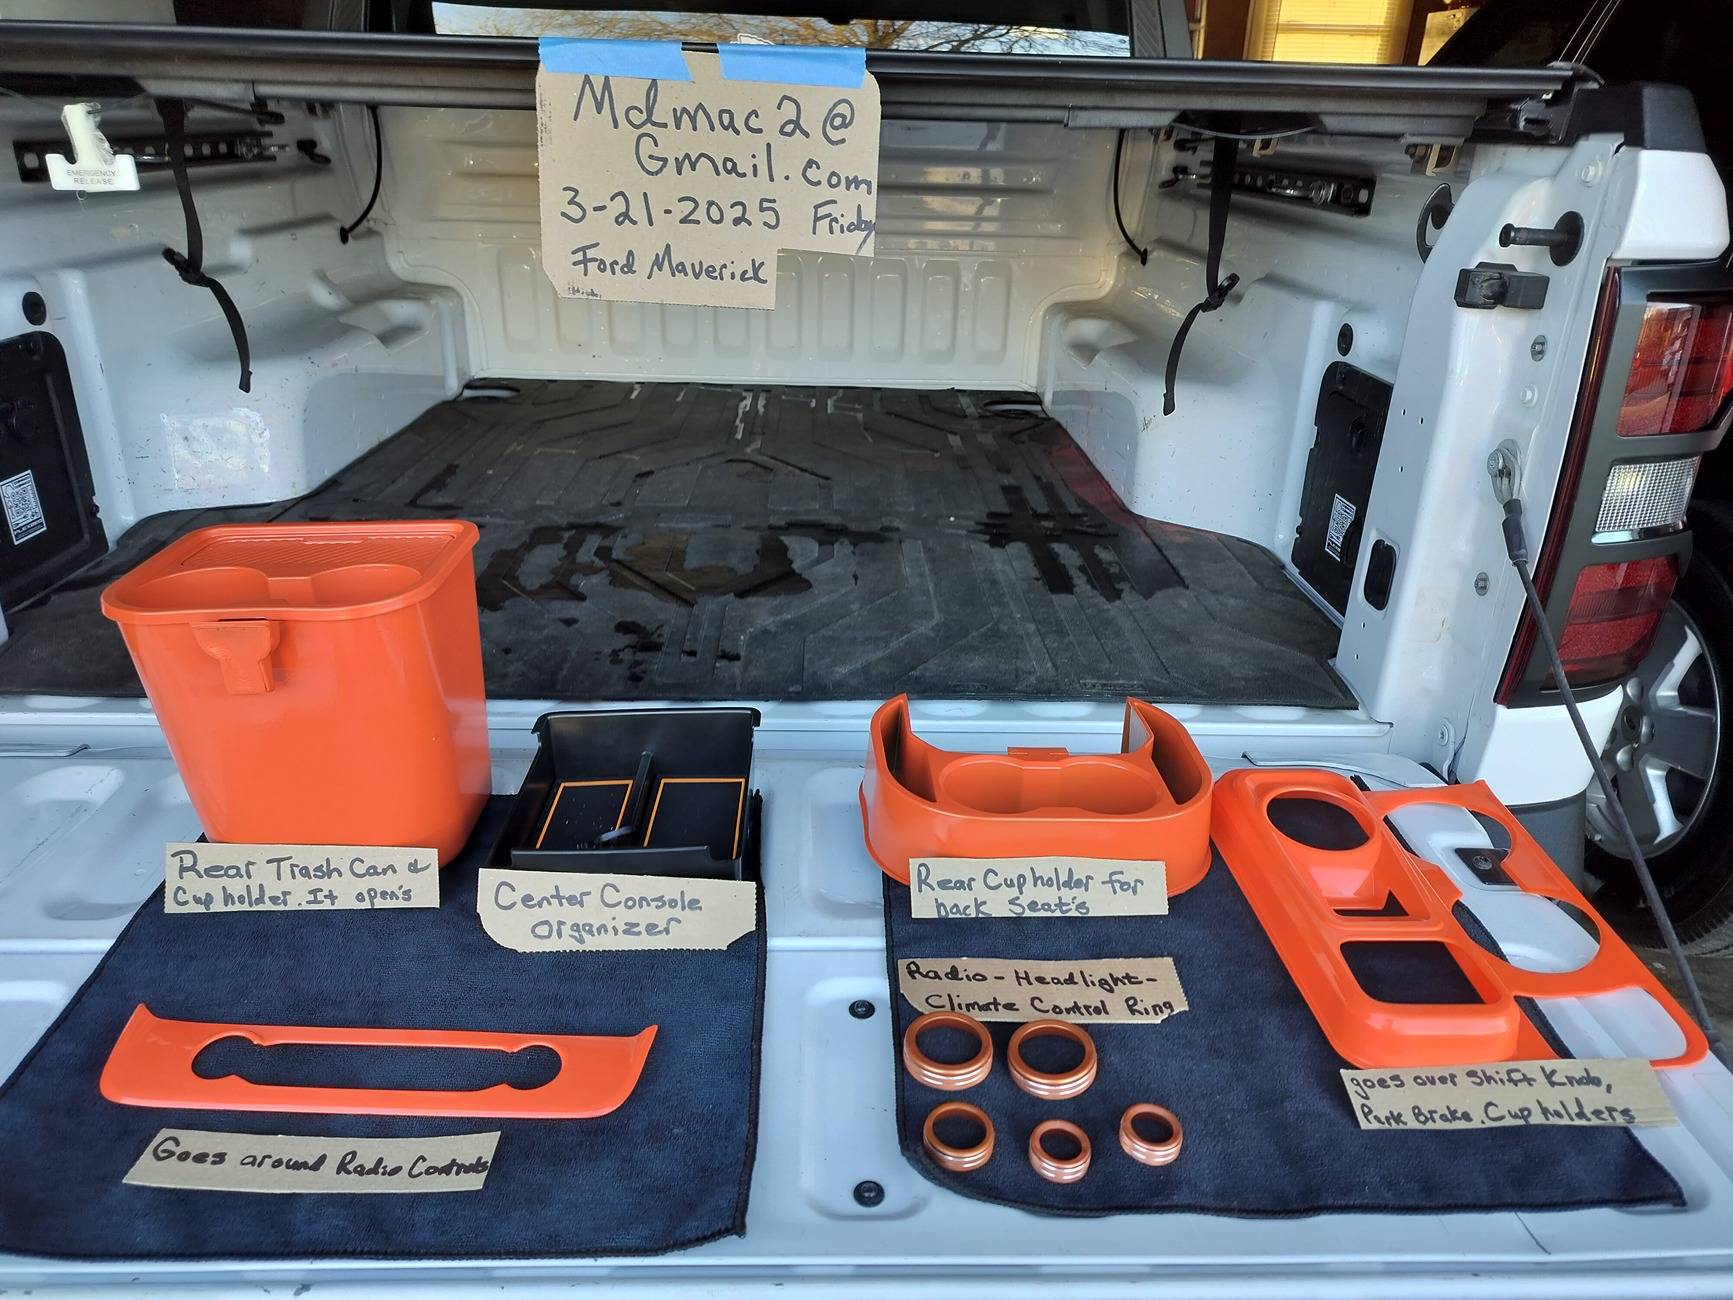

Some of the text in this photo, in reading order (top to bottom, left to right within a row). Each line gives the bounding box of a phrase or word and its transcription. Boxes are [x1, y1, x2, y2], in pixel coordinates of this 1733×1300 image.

[66, 169, 117, 177] EMERGENCY
[634, 132, 872, 195] Gmail.com
[73, 177, 114, 185] RELEASE
[560, 186, 876, 255] 3-21-2025 Friday
[571, 241, 768, 284] Ford Maverick
[171, 849, 257, 880] Rear
[266, 855, 343, 881] Trash
[349, 857, 398, 879] Can
[917, 862, 977, 893] Rear
[305, 887, 339, 906] It
[494, 880, 703, 912] Center Console
[935, 897, 993, 918] back
[925, 993, 1175, 1017] Climate Control Ring
[1413, 1072, 1458, 1087] over
[152, 1136, 489, 1178] Goes around Radio Controls
